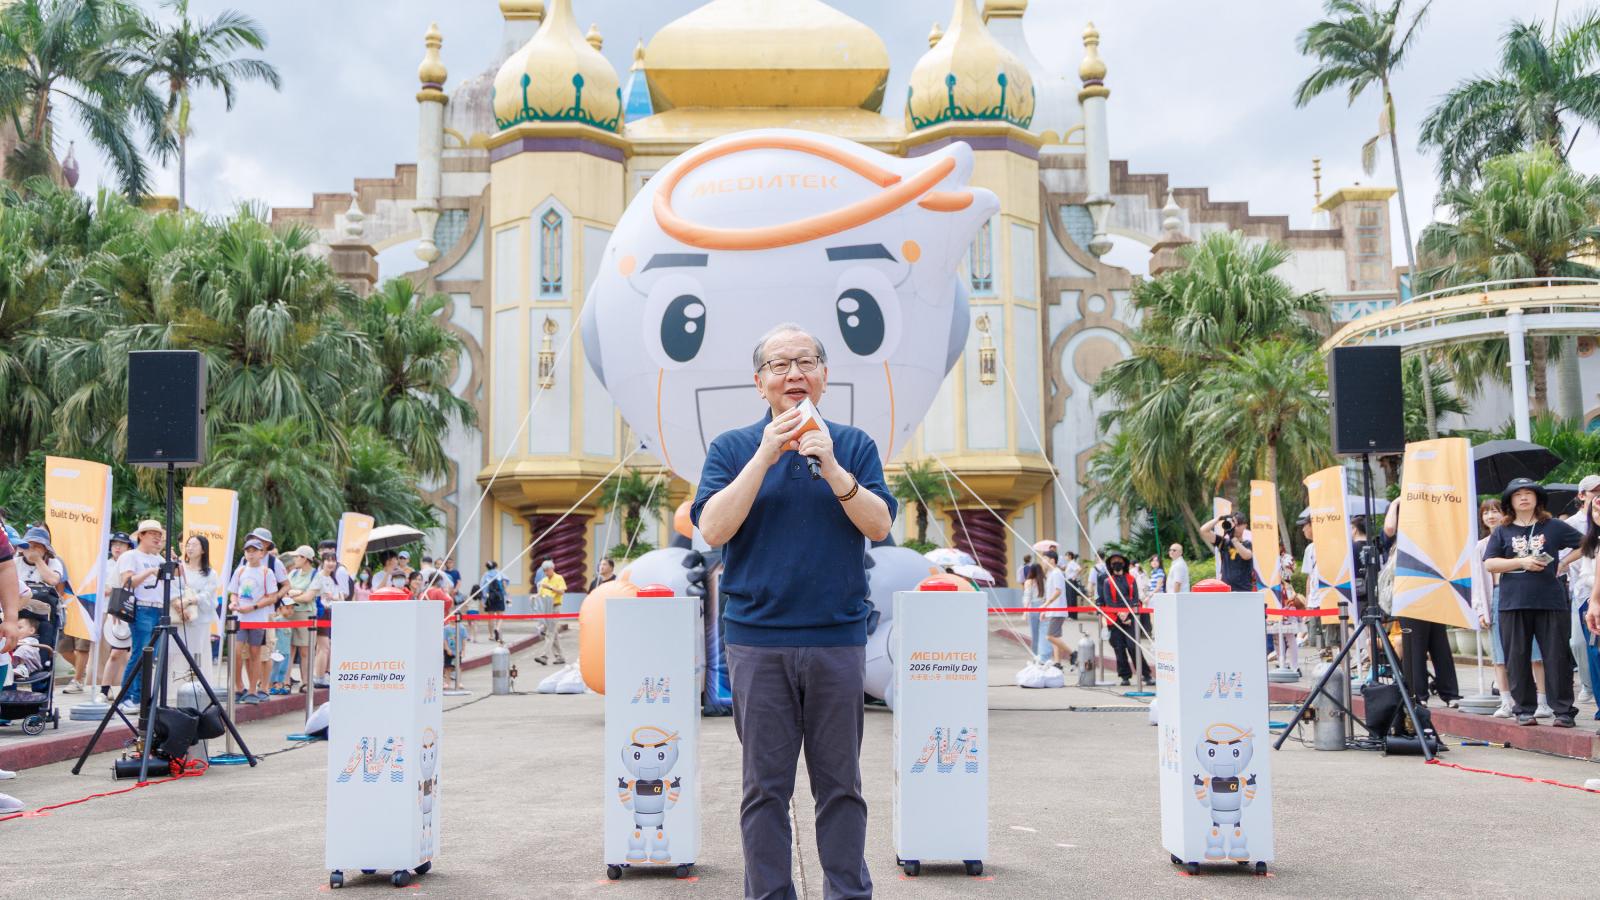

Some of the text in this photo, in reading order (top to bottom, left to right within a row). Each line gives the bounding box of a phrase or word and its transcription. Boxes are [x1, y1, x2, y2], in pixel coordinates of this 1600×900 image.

[691, 174, 839, 198] MEDIATEK
[1407, 492, 1461, 504] Built by You
[51, 509, 98, 524] Built by You
[910, 651, 977, 661] MEDIATEK
[338, 661, 406, 671] MEDIATEK
[932, 664, 960, 673] Family
[961, 664, 978, 673] Day
[337, 673, 406, 682] 2026 Family Day
